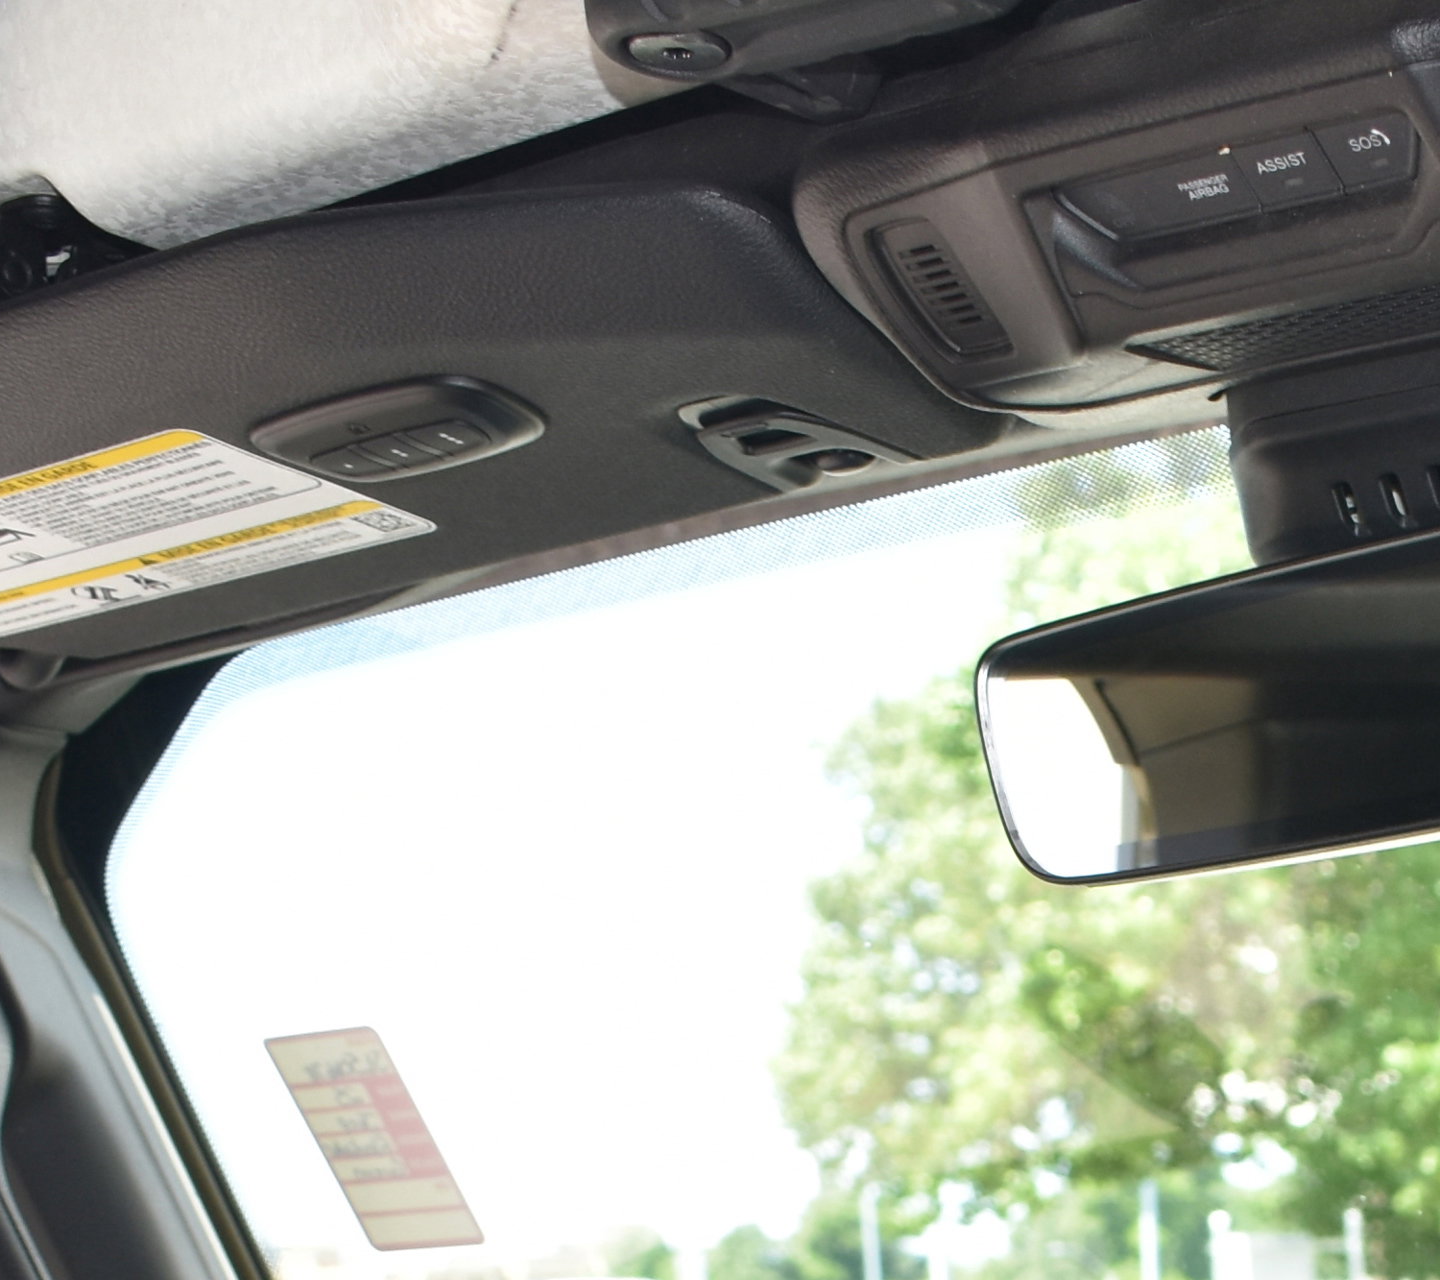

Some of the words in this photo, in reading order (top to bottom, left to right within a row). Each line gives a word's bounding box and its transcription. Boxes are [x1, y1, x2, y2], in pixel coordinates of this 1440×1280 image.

[1348, 133, 1382, 152] SOS
[1256, 152, 1307, 174] ASSIST
[1177, 174, 1228, 192] PASSENGER
[1189, 183, 1229, 201] AIRBAG
